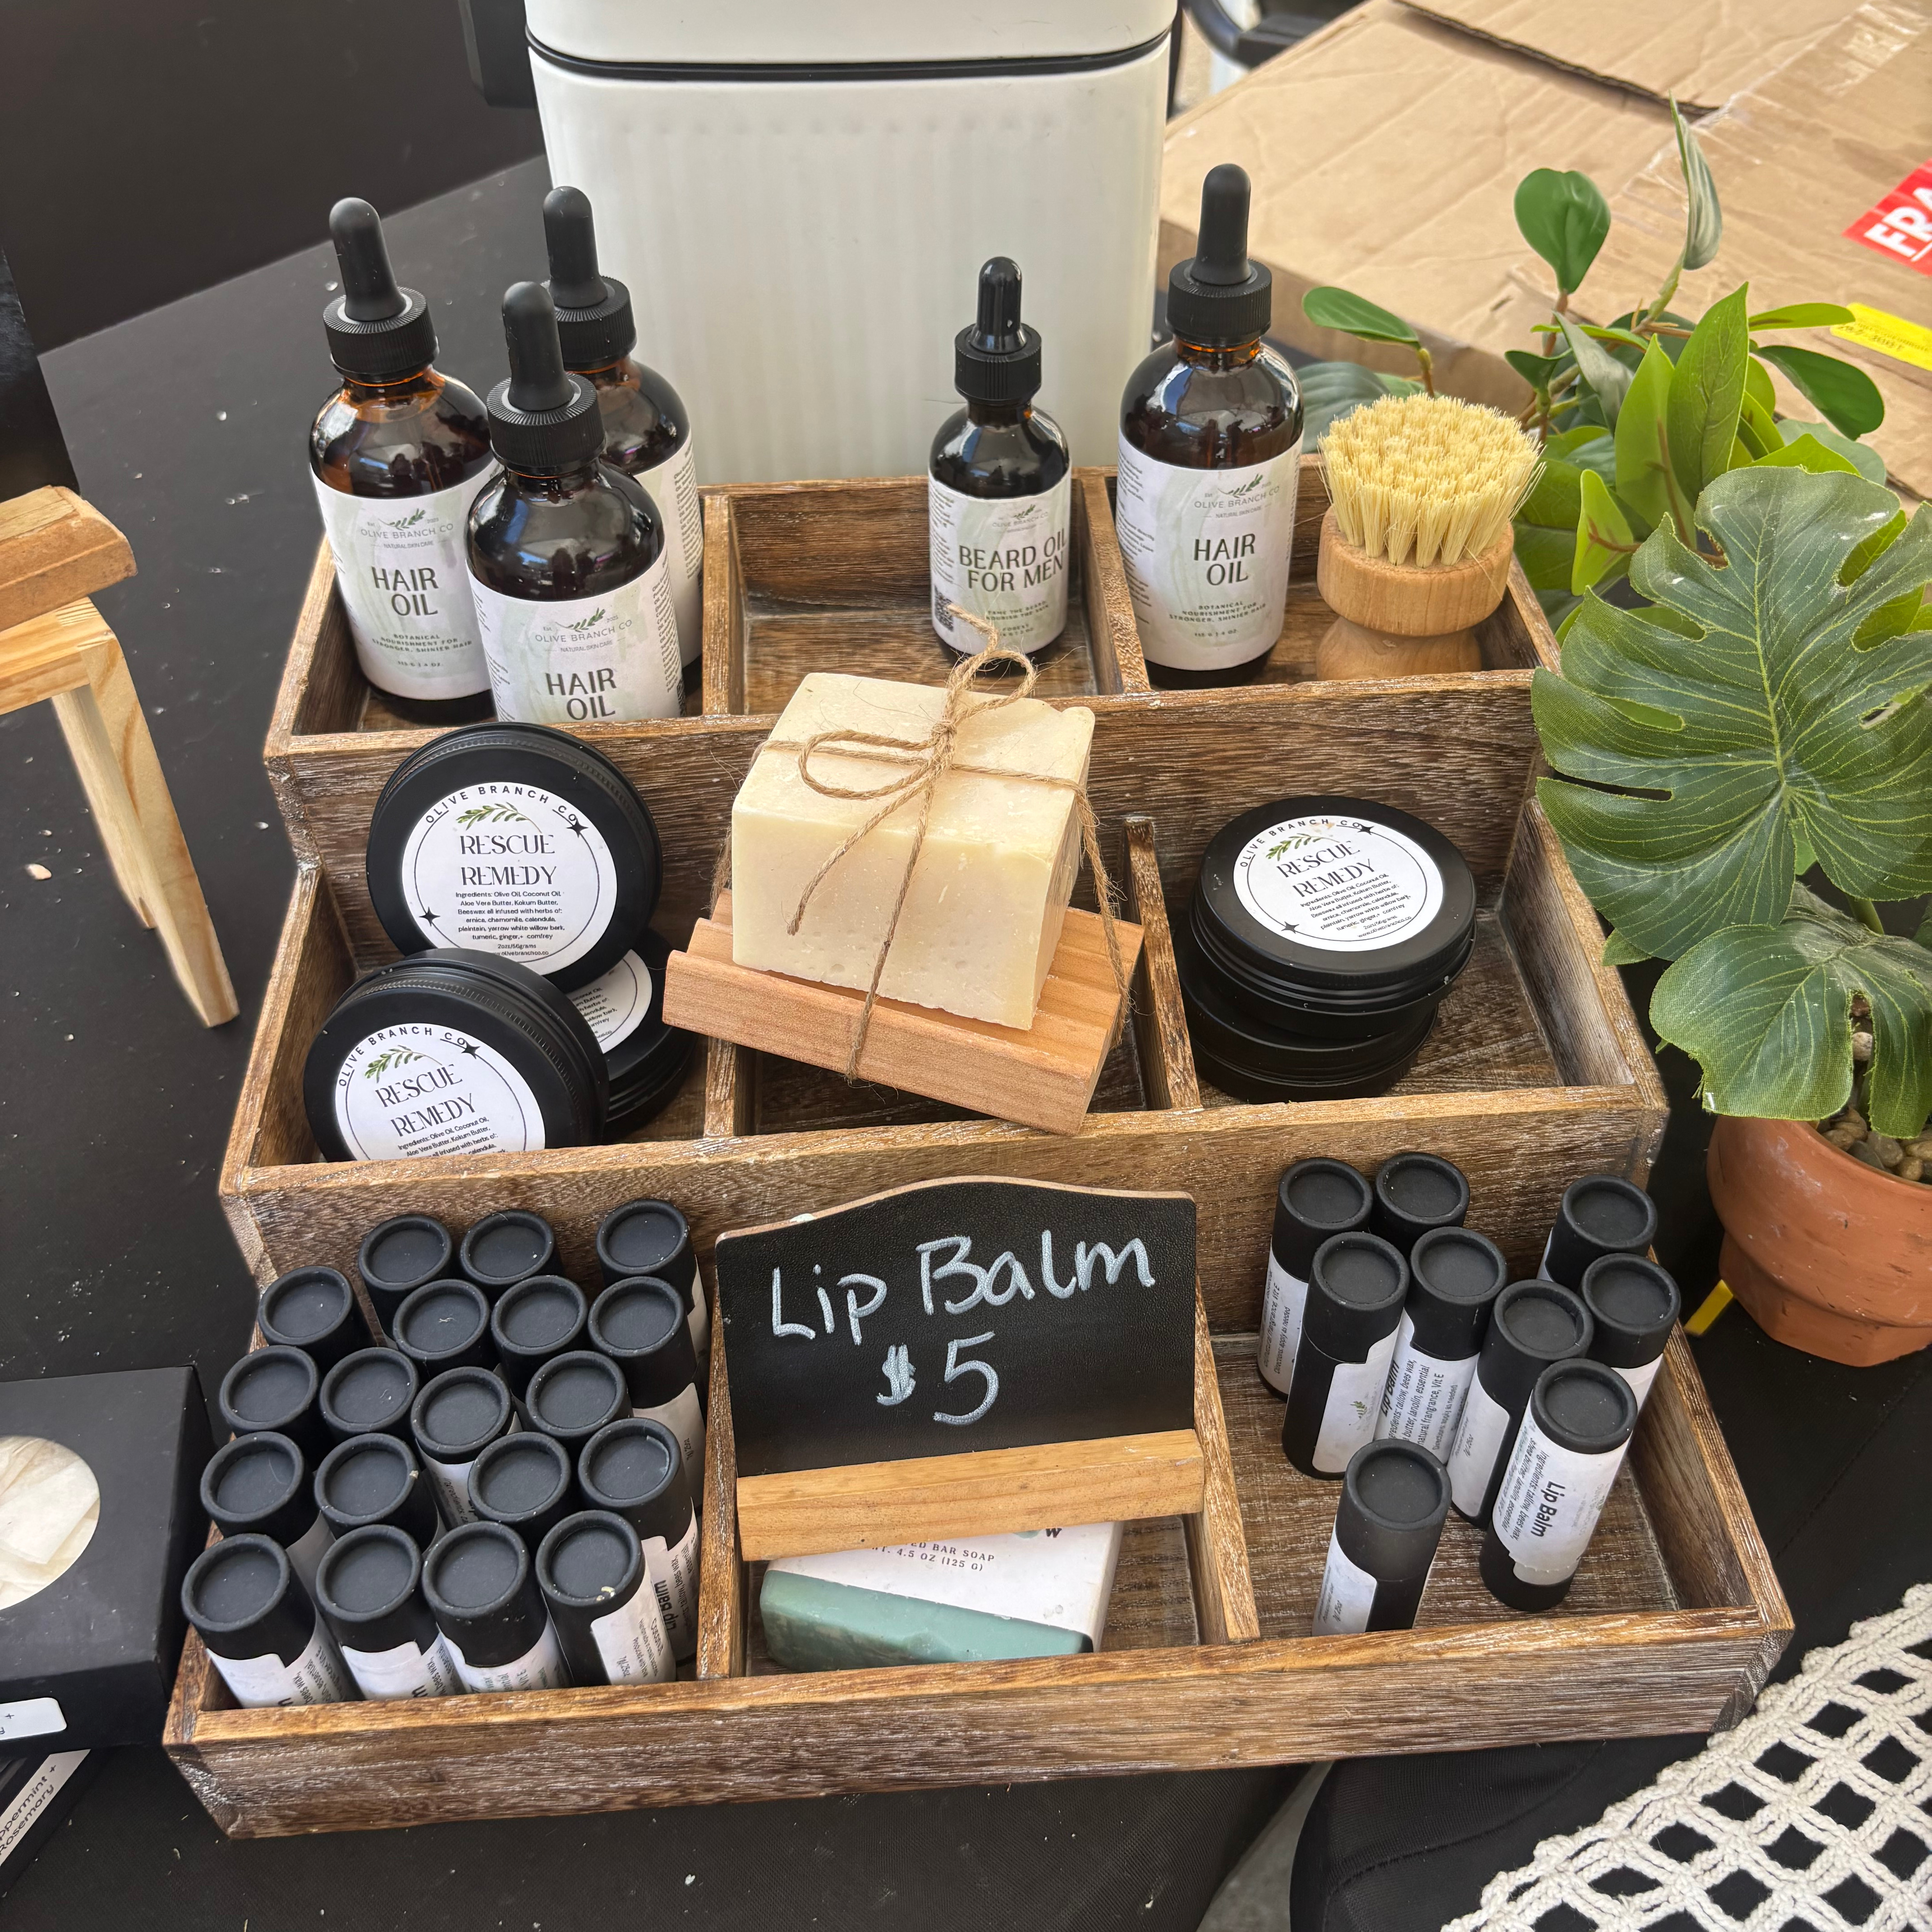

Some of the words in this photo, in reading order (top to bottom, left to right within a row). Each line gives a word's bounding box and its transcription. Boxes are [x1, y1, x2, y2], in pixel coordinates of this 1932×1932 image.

[1228, 492, 1266, 507] BRANCH
[1269, 486, 1279, 496] CO
[361, 529, 388, 538] OLIVE
[392, 528, 436, 538] BRANCH
[440, 524, 453, 532] CO
[959, 545, 1036, 570] BEARD
[1044, 528, 1065, 557] OIL
[1194, 533, 1255, 561] HAIR
[372, 566, 438, 591] HAIR
[968, 570, 1014, 592] FOR
[1024, 552, 1063, 588] MEN
[1207, 561, 1248, 586] OIL
[391, 593, 438, 616] OIL
[1182, 607, 1239, 616] NOURISHMENT
[1198, 601, 1243, 610] BOTANICAL
[381, 637, 437, 646] NOURISHMENT
[572, 626, 615, 642] BRANCH
[619, 620, 632, 630] CO
[546, 668, 616, 695] HAIR
[567, 696, 615, 720] OIL
[426, 791, 468, 823] OLIVE
[478, 786, 548, 803] BRANCH
[558, 805, 577, 821] CO
[460, 835, 555, 854] RESCUE
[1240, 838, 1265, 867] OLIVE
[1269, 819, 1329, 836] BRANCH
[1276, 841, 1360, 878] RESCUE
[461, 866, 557, 885] REMEDY
[1292, 859, 1374, 897] REMEDY
[1356, 877, 1380, 888] Coconut
[339, 1047, 364, 1087] OLIVE
[368, 1027, 432, 1045] BRANCH
[444, 1033, 467, 1045] CO
[376, 1064, 463, 1108] RESCUE
[391, 1093, 476, 1137] REMEDY
[398, 1136, 429, 1150] Ingredients:
[455, 1120, 479, 1131] Coconut
[772, 1264, 888, 1345] Lip
[915, 1228, 1156, 1316] Balm
[1400, 1371, 1411, 1389] bees
[1406, 1359, 1416, 1374] wax,
[1416, 1364, 1430, 1395] essential
[1410, 1395, 1423, 1421] lanolin,
[1417, 1419, 1430, 1444] natural
[1431, 1378, 1443, 1390] Vit
[1404, 1414, 1417, 1437] butter,
[1530, 1450, 1550, 1493] Ingredients:
[1521, 1489, 1535, 1511] tallow,
[1541, 1481, 1565, 1503] Lip
[1502, 1500, 1514, 1532] essential
[1517, 1510, 1529, 1528] bees
[1531, 1504, 1557, 1537] Balm
[1510, 1525, 1522, 1541] wax,
[681, 1543, 693, 1573] essential
[897, 1549, 914, 1557] 4.5
[920, 1553, 936, 1562] OZ
[942, 1557, 965, 1568] (125
[933, 1544, 956, 1555] BAR
[963, 1550, 995, 1561] SOAP
[675, 1570, 683, 1588] bees
[305, 1659, 324, 1689] essential
[426, 1657, 437, 1675] wax,
[293, 1671, 305, 1688] wax,
[432, 1672, 443, 1692] bees
[300, 1686, 313, 1704] bees
[0, 1776, 47, 1840] ppermint
[0, 1785, 54, 1855] Rosemary
